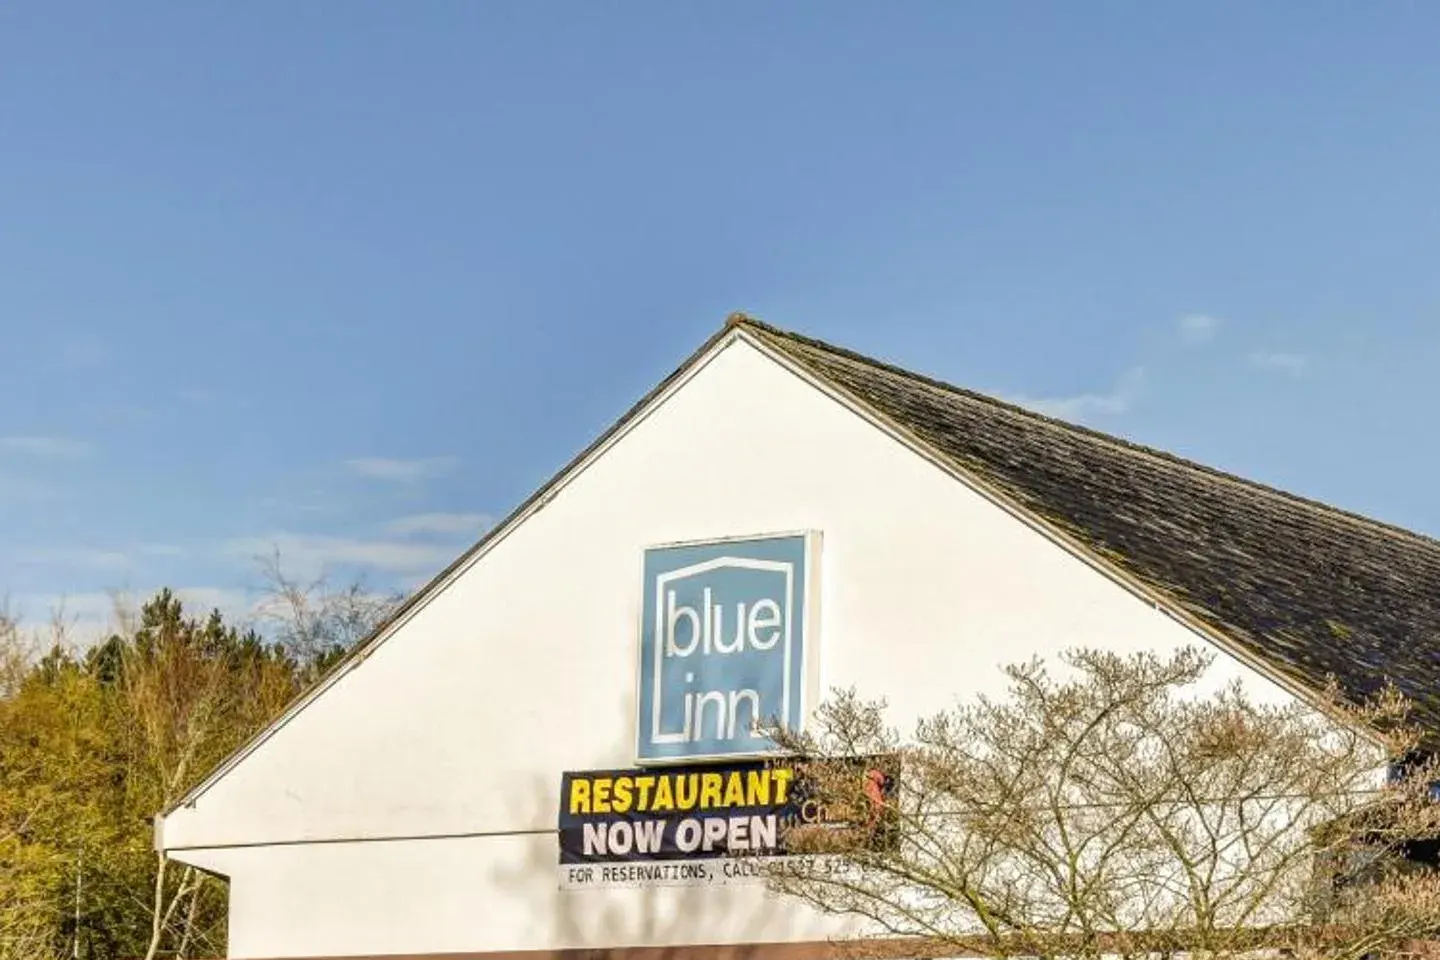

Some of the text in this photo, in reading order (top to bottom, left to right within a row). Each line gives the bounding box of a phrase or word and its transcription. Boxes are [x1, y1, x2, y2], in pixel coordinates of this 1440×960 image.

[667, 587, 781, 658] blue
[684, 672, 761, 742] inn
[570, 769, 793, 815] RESTAURANT
[583, 814, 778, 856] NOW OPEN
[569, 868, 594, 883] FOR
[602, 863, 714, 882] RESERVATIONS,
[723, 862, 759, 878] CALL
